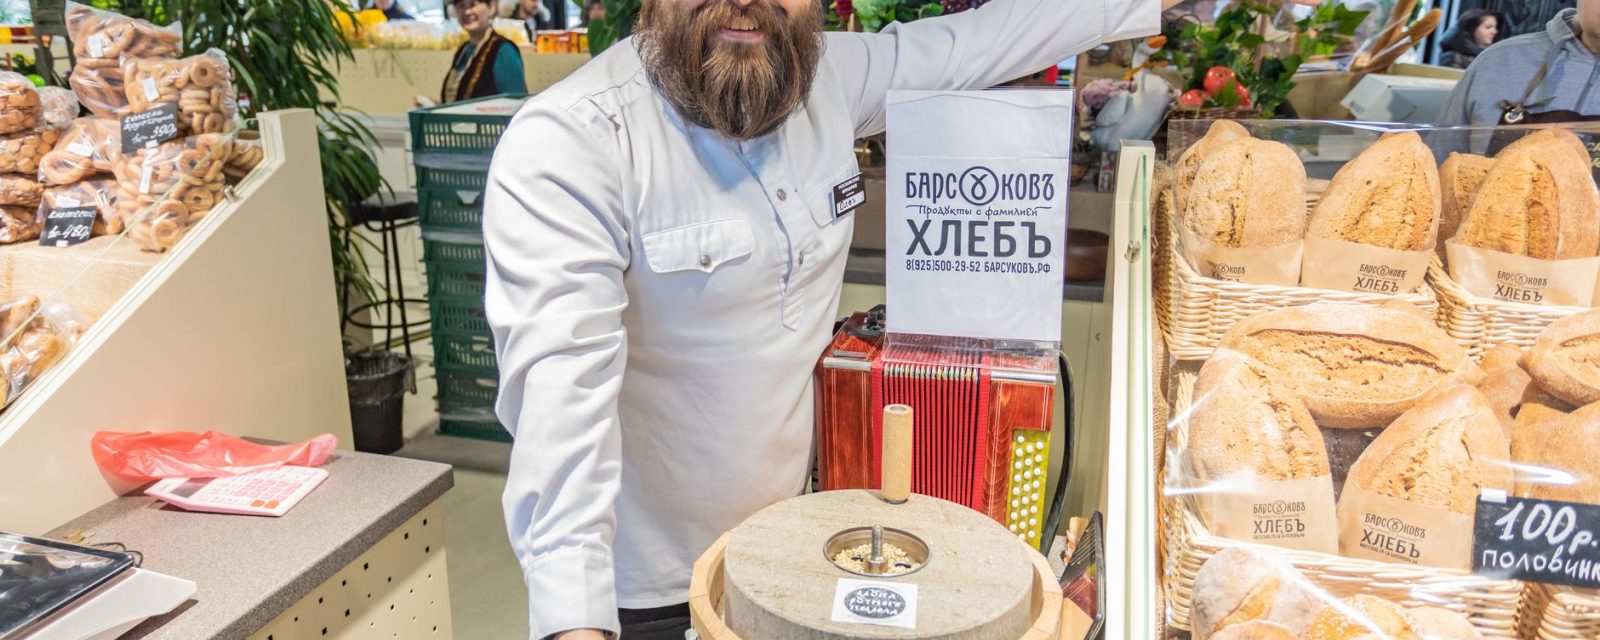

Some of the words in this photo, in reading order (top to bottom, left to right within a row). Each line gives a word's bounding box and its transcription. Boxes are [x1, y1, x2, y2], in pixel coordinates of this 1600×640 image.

[906, 219, 1052, 258] ХЛЕБЪ
[906, 259, 981, 272] 8(925)500-29-52
[984, 260, 1051, 274] БАРСУКОВЪ.РФ
[1354, 276, 1399, 293] ХЛЕБЪ
[1494, 283, 1543, 302] ХЛЕБЪ
[1253, 518, 1306, 534] ХЛЕБЪ
[1361, 528, 1421, 559] ХЛЕБЪ
